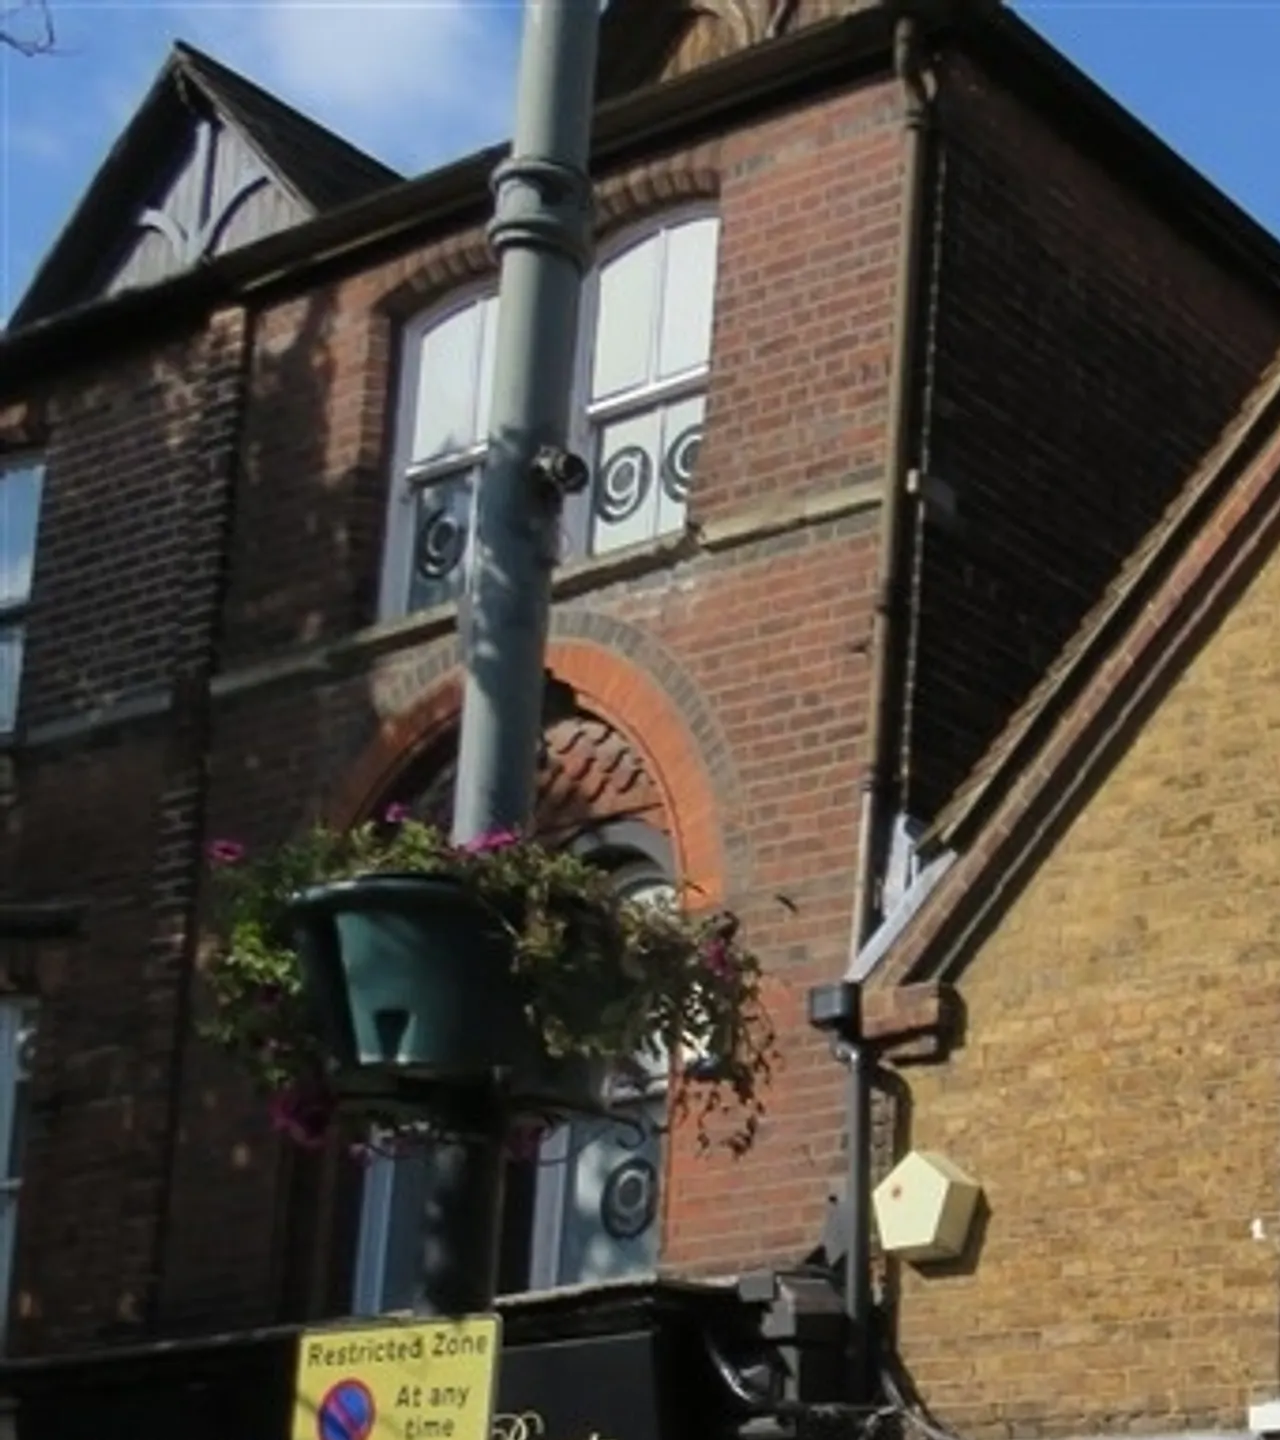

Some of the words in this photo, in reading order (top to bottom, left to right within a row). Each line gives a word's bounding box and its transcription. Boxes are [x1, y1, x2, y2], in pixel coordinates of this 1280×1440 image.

[306, 1335, 425, 1369] Restricted
[431, 1331, 489, 1358] Zone
[395, 1384, 423, 1409] At
[431, 1384, 471, 1408] any
